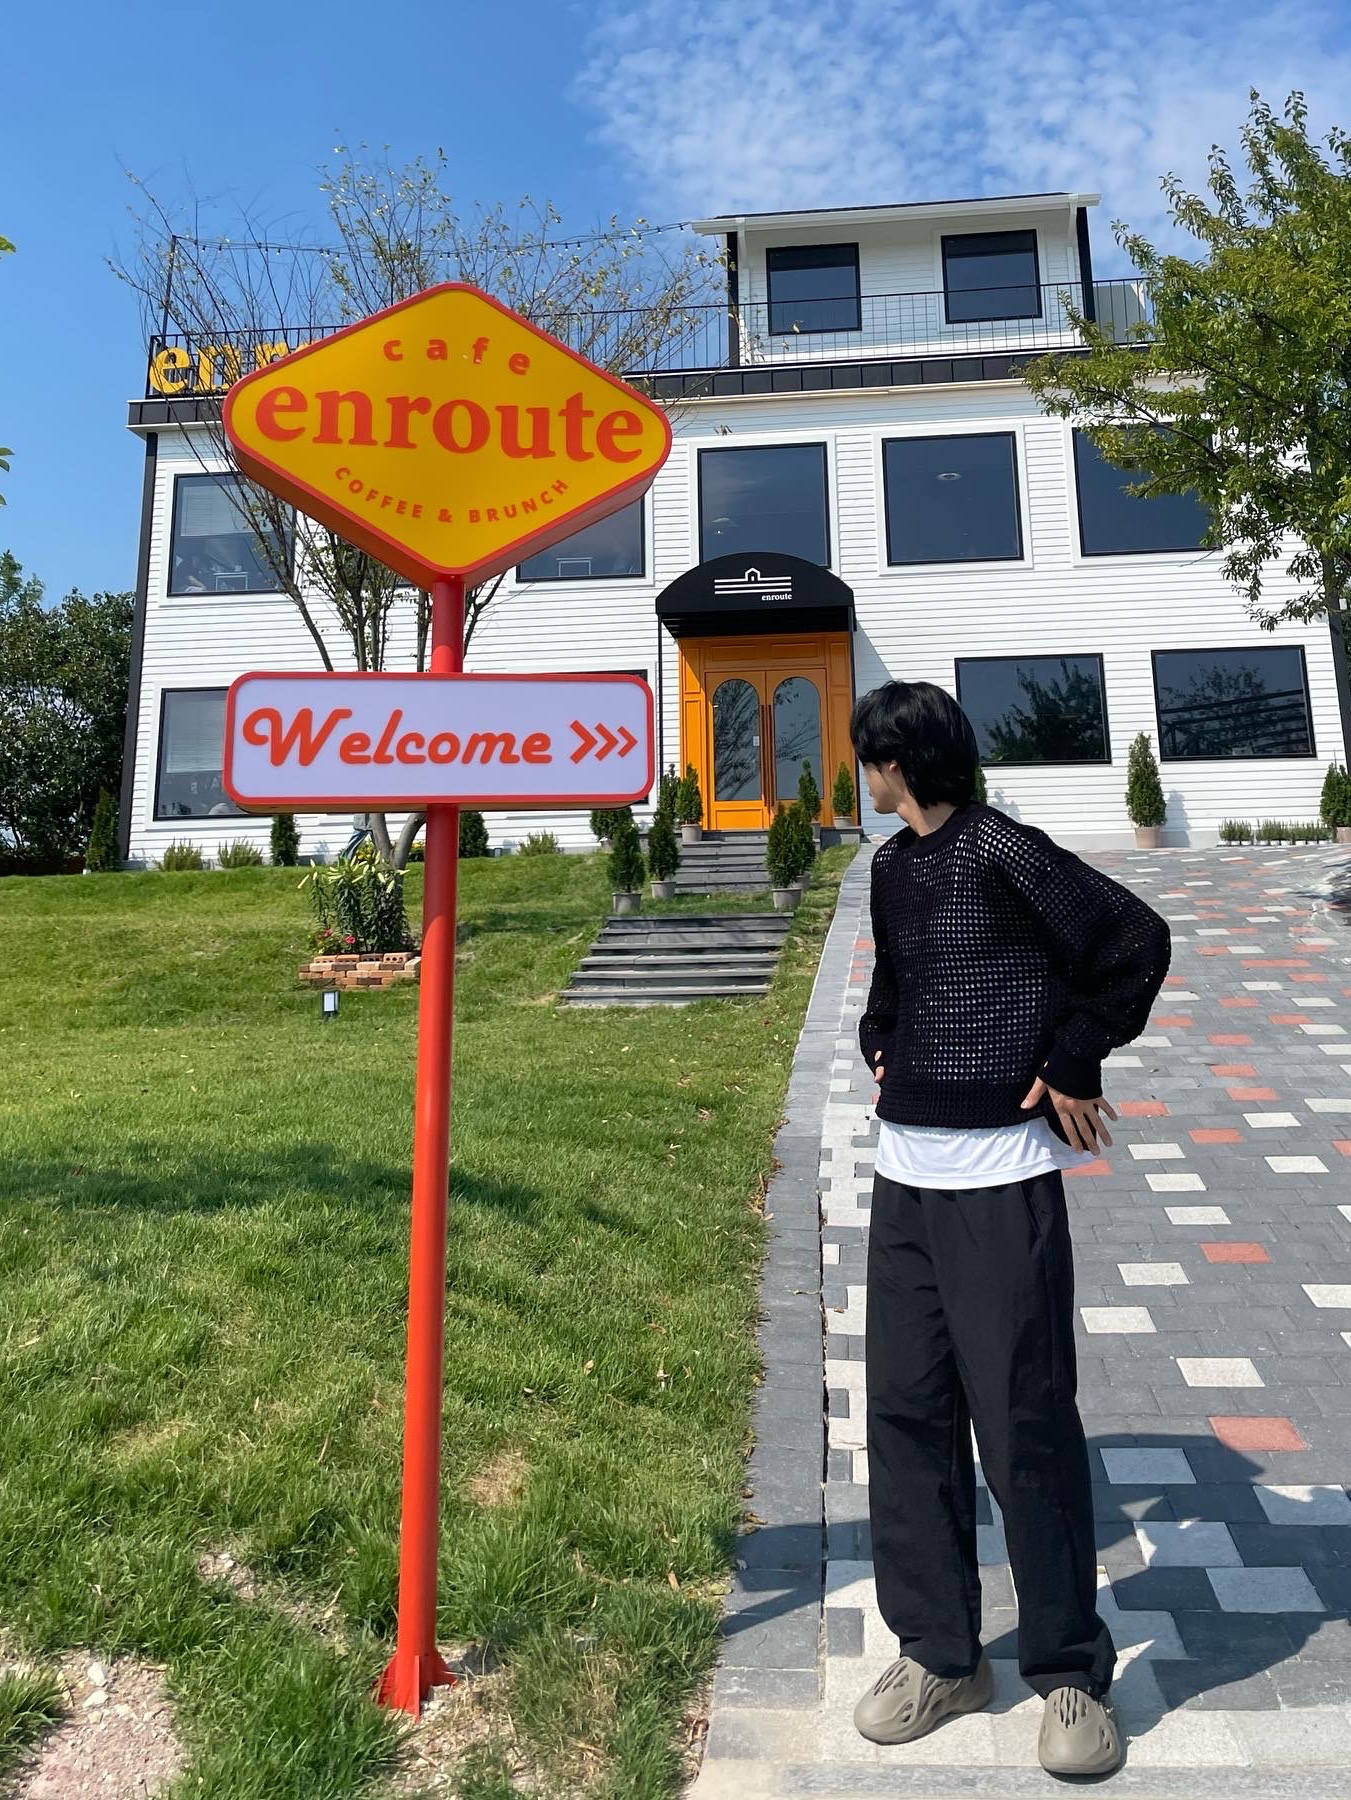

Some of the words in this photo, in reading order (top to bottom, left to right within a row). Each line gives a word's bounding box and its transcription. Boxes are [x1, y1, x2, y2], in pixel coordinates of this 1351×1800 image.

[382, 335, 531, 376] cafe
[254, 384, 645, 464] enroute
[334, 466, 422, 520] COFFEE
[437, 507, 454, 524] &
[468, 478, 570, 523] BRUNCH
[761, 593, 793, 601] enroute
[242, 706, 553, 768] Welcome
